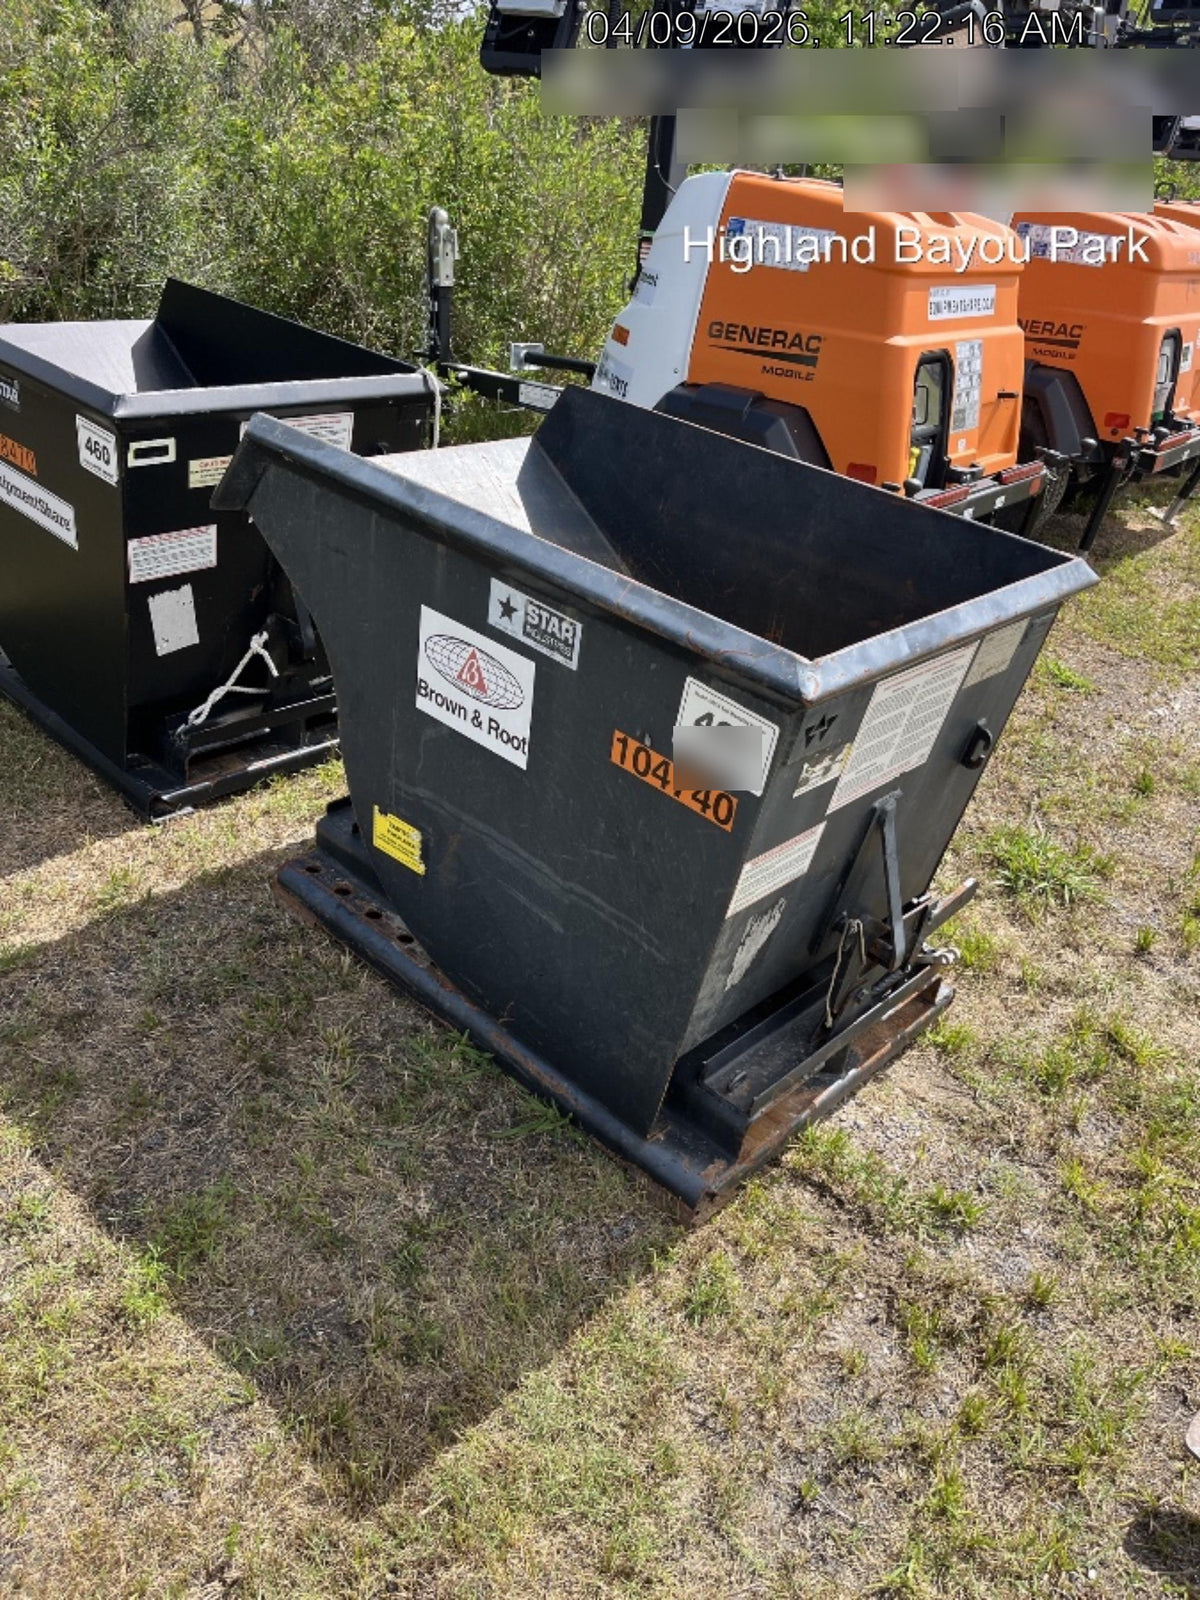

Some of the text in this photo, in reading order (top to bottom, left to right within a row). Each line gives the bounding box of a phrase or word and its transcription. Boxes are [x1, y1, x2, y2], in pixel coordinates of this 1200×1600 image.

[708, 321, 822, 354] GENERAC
[1017, 318, 1083, 339] NERAC
[1032, 347, 1077, 360] MOBILE
[760, 365, 815, 381] MOBILE
[84, 435, 111, 467] 460
[526, 603, 574, 645] STAR
[417, 678, 528, 756] Brown & Root
[616, 735, 734, 826] 10440
